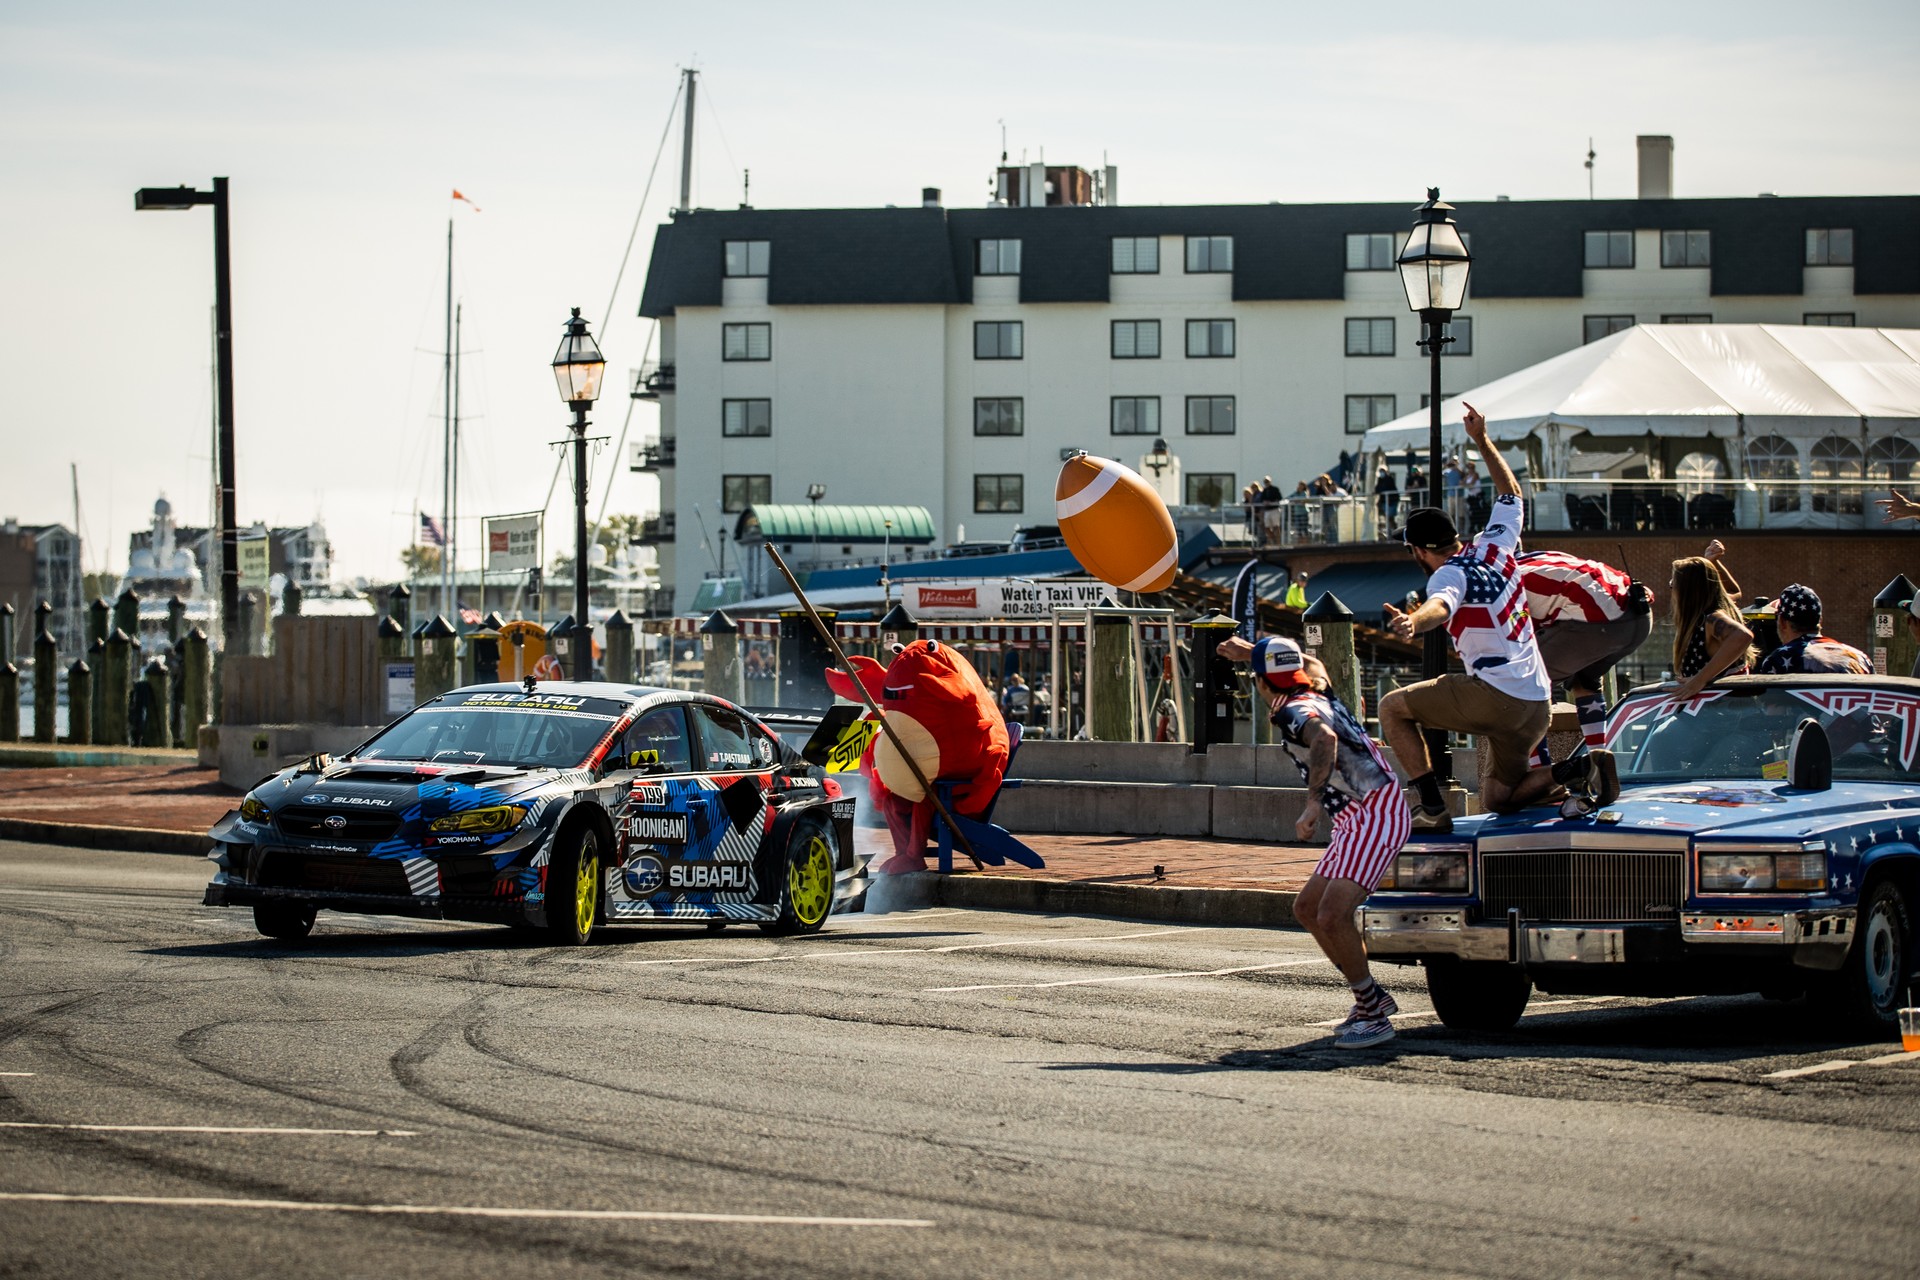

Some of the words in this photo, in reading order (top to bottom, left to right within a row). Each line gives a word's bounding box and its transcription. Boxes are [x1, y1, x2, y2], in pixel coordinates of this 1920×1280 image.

[921, 590, 975, 602] Watermark
[1001, 587, 1041, 601] Water
[1046, 587, 1073, 601] Taxi
[1077, 587, 1104, 600] VHF
[1308, 626, 1318, 634] B6
[468, 693, 587, 707] SUBARU
[643, 786, 665, 804] 199
[332, 796, 393, 807] SUBARU
[832, 803, 844, 813] BLACK
[845, 803, 855, 814] RIFLE
[437, 836, 481, 844] YOKOHAMA
[669, 865, 747, 888] SUBARU
[1645, 903, 1675, 912] Cadillac
